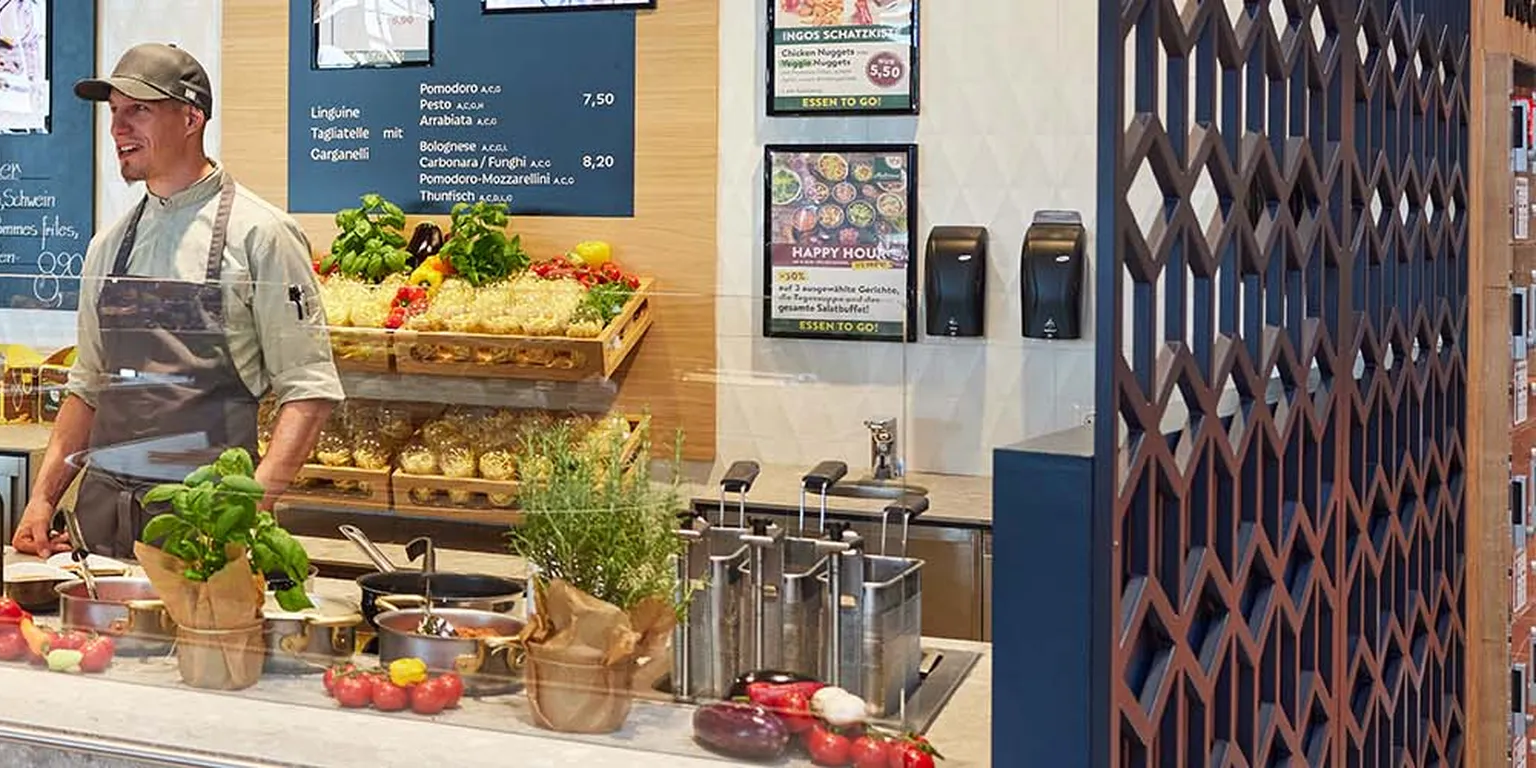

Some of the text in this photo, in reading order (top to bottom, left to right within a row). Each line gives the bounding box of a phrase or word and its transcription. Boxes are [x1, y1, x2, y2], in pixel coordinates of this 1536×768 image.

[783, 29, 898, 41] INGOS SCHATZKIST
[781, 48, 816, 57] Chicken
[818, 48, 855, 58] Nuggets
[814, 58, 851, 67] Nuggets
[870, 65, 900, 78] 5,50
[420, 83, 478, 94] Pomodoro
[420, 99, 452, 110] Pesto
[583, 93, 615, 107] 7,50
[802, 96, 882, 107] ESSEN TO GO!
[311, 105, 360, 120] Linguine
[419, 114, 472, 126] Arrabiata
[310, 126, 404, 141] Tagliatelle mit
[419, 141, 477, 154] Bolognese
[311, 147, 370, 162] Garganelli
[419, 156, 478, 168] Carbonara
[488, 156, 526, 171] Funghi
[582, 155, 615, 170] 8,20
[419, 172, 550, 185] Pomodoro-Mozzarellini
[420, 190, 475, 202] Thunfisch
[792, 246, 840, 259] HAPPY
[778, 303, 815, 314] gesamte
[799, 321, 879, 333] ESSEN TO GO!
